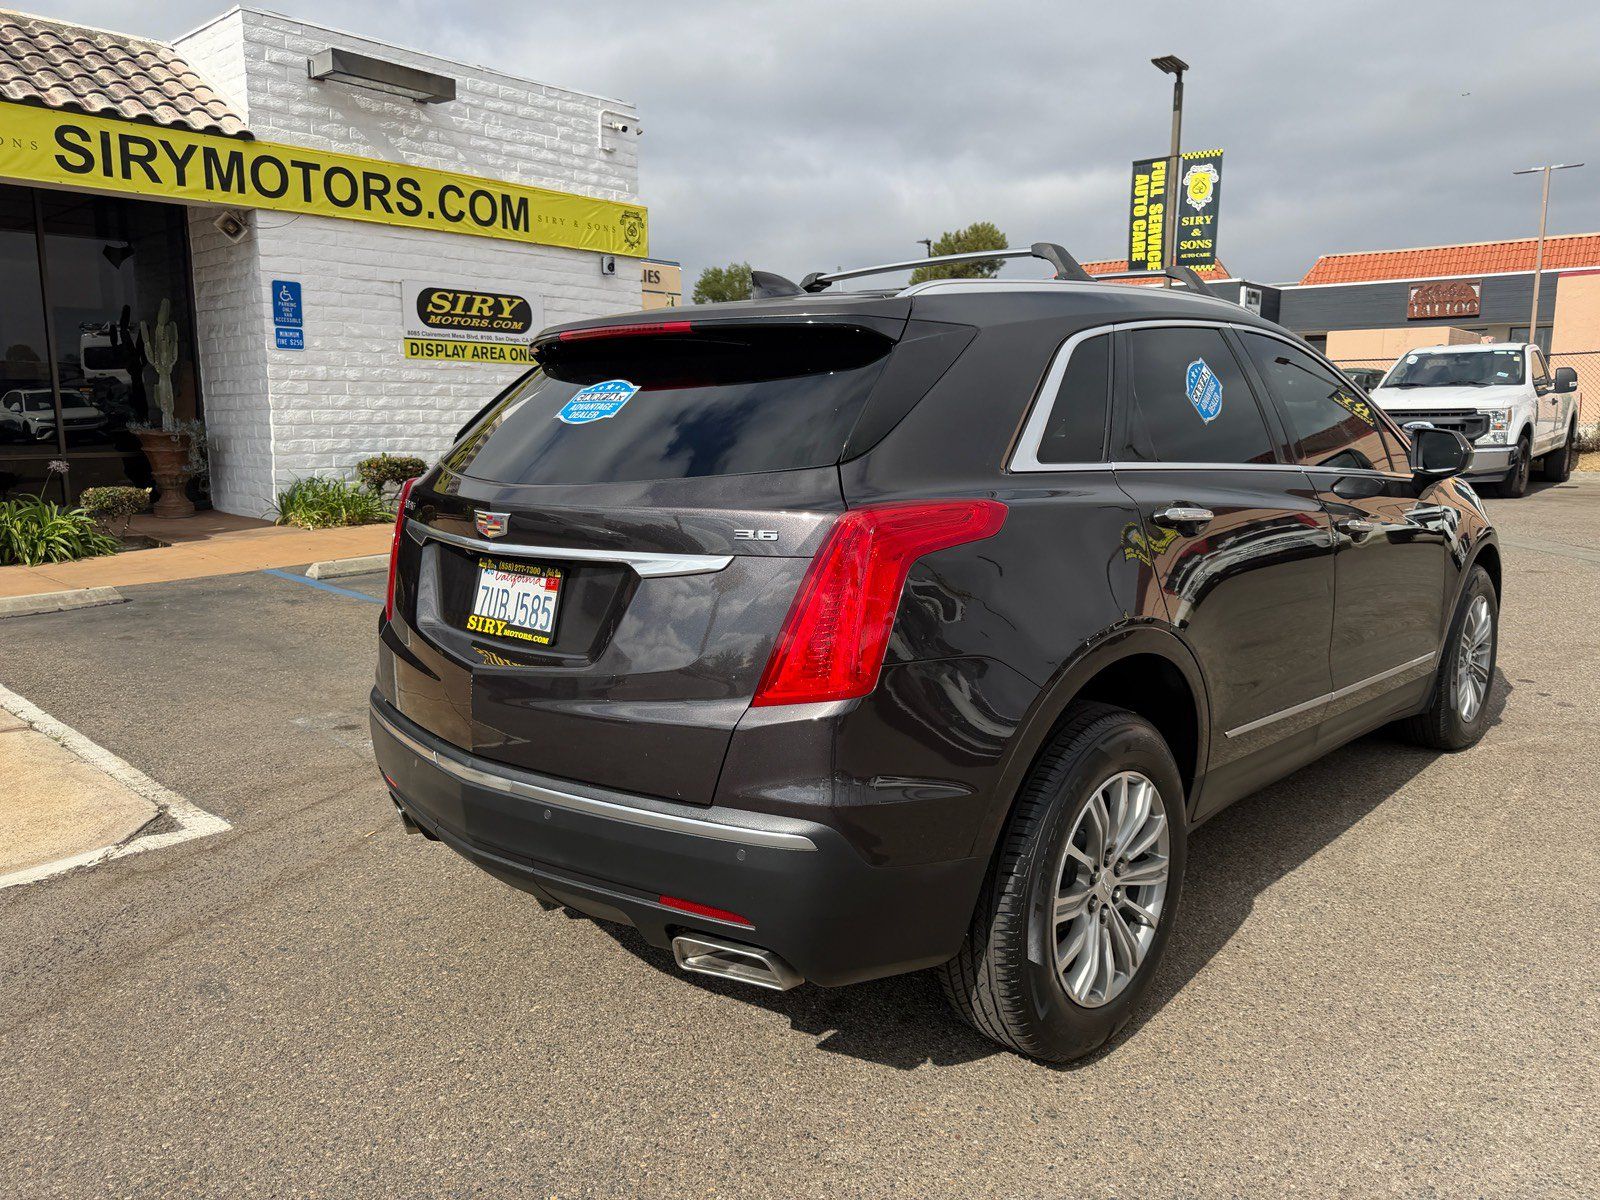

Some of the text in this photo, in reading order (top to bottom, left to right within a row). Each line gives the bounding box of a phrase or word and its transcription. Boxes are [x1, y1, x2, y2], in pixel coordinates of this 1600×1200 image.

[54, 124, 530, 232] SIRYMOTORS.COM
[537, 214, 616, 234] SIRY & SONS
[1132, 174, 1149, 261] AUTO CARE
[1147, 161, 1166, 271] FULL SERVICE
[1181, 215, 1213, 226] SIRY
[1191, 228, 1202, 237] &
[1180, 239, 1212, 250] SONS
[426, 291, 524, 318] SIRY
[428, 314, 524, 330] MOTORS.COM
[277, 338, 288, 346] FINE
[421, 330, 451, 339] Clairemont
[410, 342, 467, 359] DISPLAY
[472, 345, 506, 361] AREA
[567, 411, 600, 419] DEALER
[569, 402, 614, 411] ADVANTAGE
[733, 529, 778, 541] 3.6
[494, 570, 546, 588] California
[479, 584, 553, 630] 7UBJ585
[467, 614, 550, 645] SIRY MOTORS.COM
